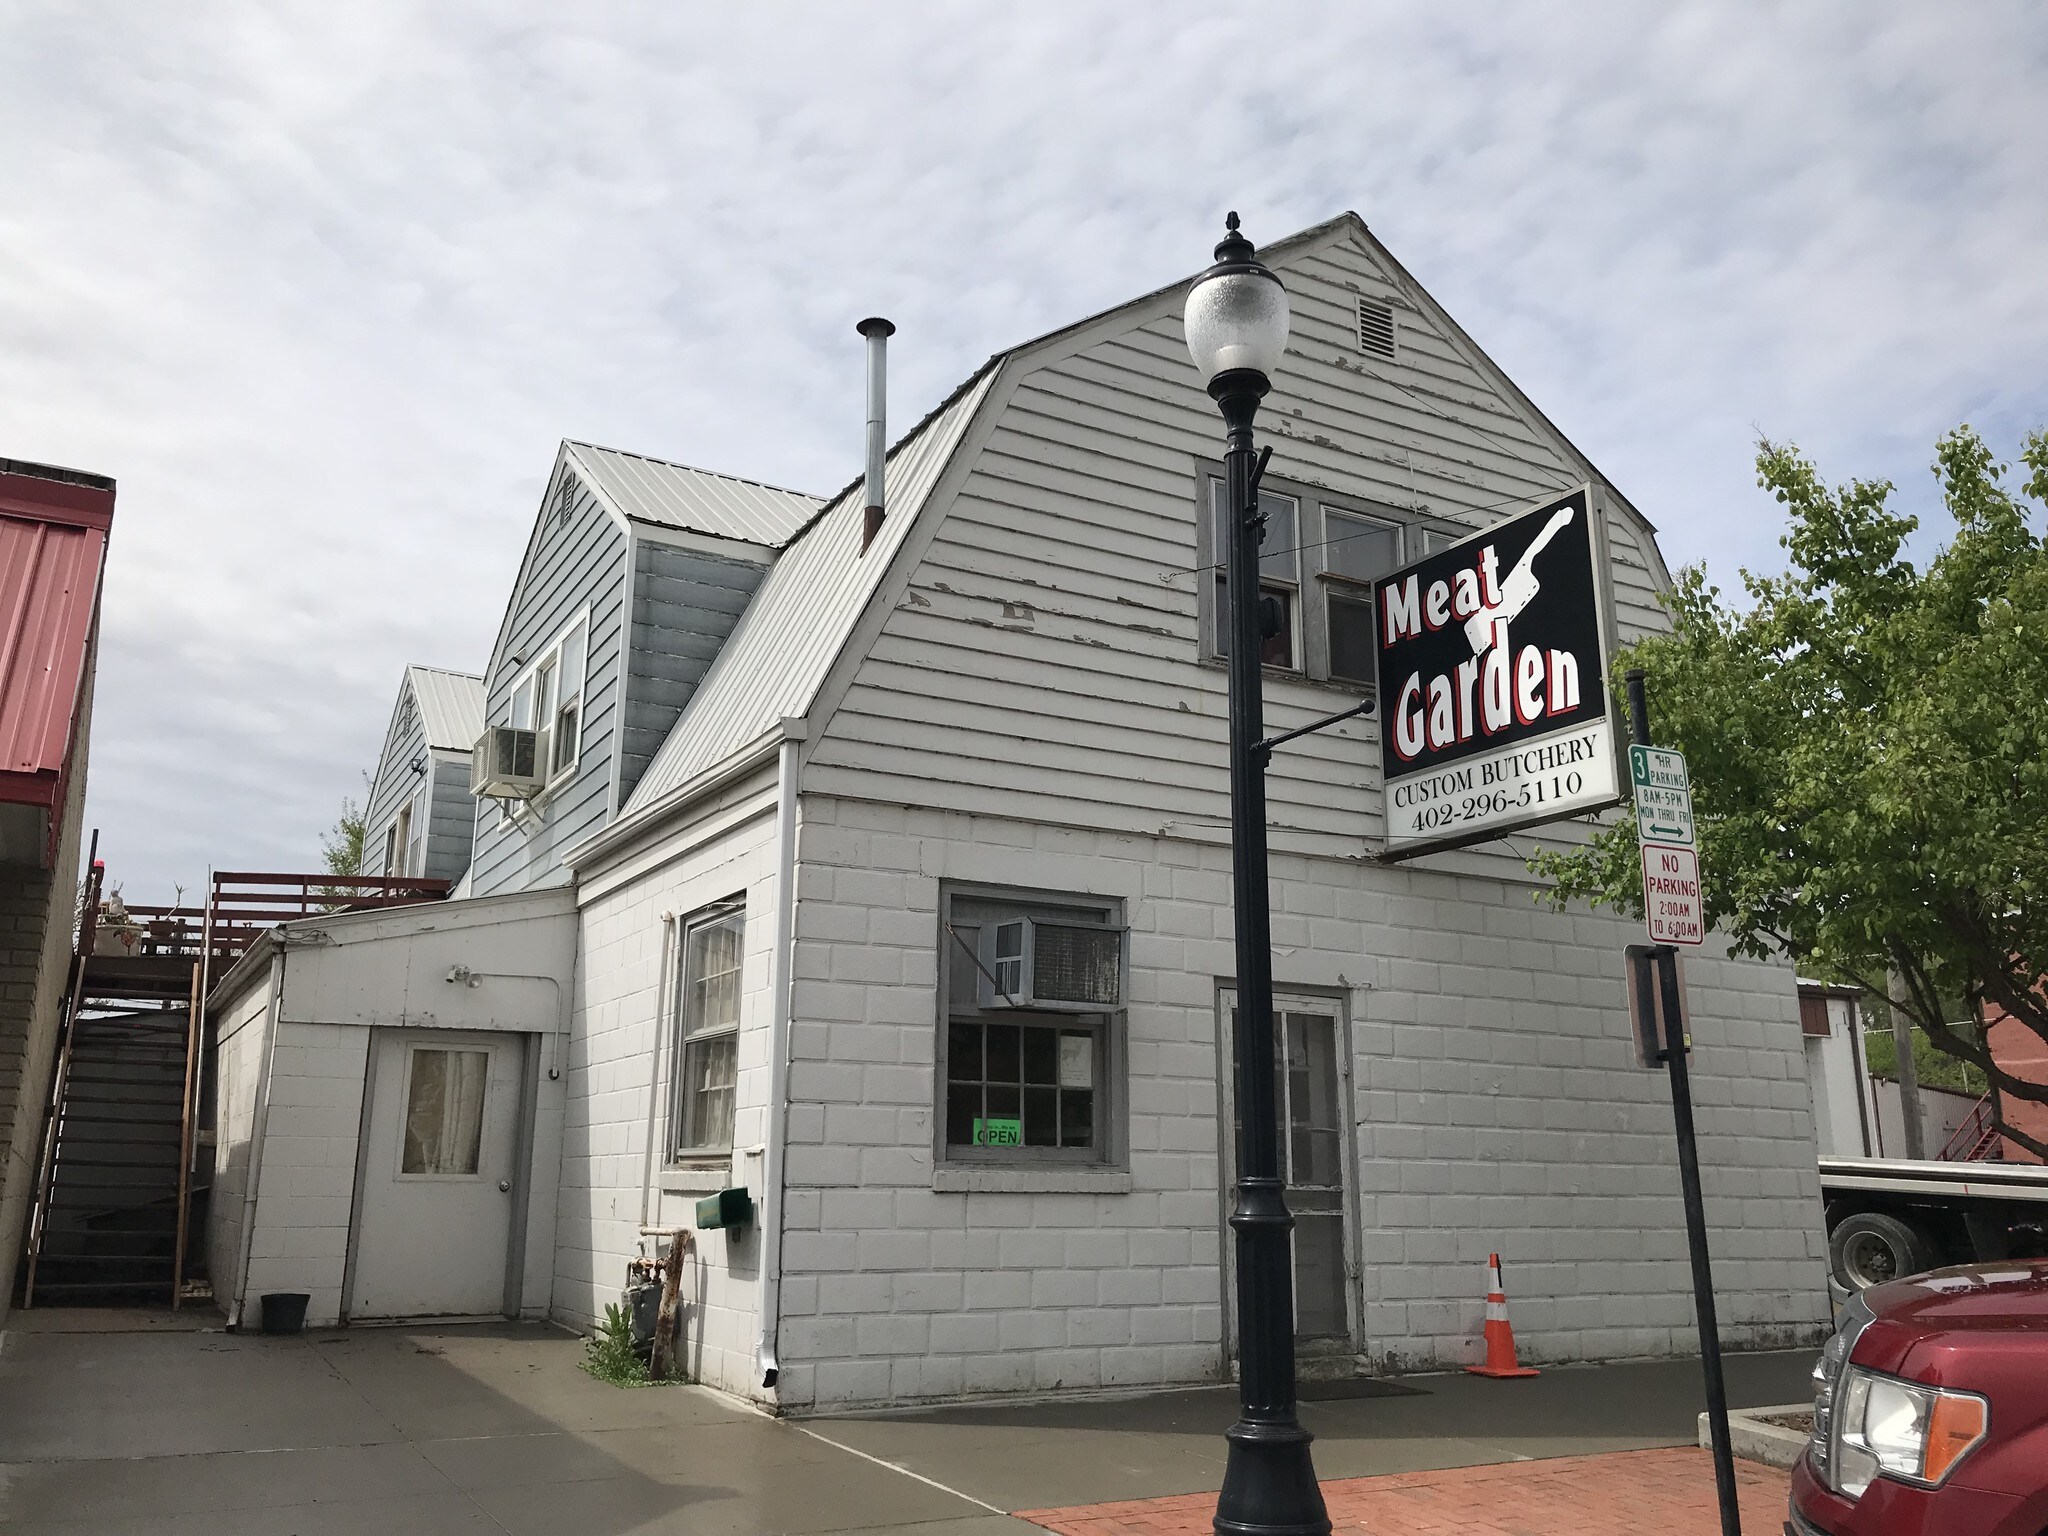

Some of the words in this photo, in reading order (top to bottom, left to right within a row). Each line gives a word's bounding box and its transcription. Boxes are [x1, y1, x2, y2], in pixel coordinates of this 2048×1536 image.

[1383, 544, 1504, 649] Meat
[1392, 616, 1581, 762] Garden
[1394, 767, 1474, 808] CUSTOM
[1480, 733, 1598, 786] BUTCHERY
[1633, 751, 1646, 780] 3
[1658, 755, 1672, 769] HR
[1650, 770, 1684, 787] PARKING
[1411, 771, 1583, 832] 402-296-5110
[1643, 788, 1683, 807] 8AM-5PM
[1639, 805, 1655, 819] MON
[1657, 808, 1675, 822] THRU
[1678, 811, 1690, 824] FRI
[1661, 854, 1679, 873] NO
[1648, 876, 1696, 897] PARKING
[1659, 900, 1690, 917] 2:00AM
[1653, 919, 1664, 934] TO
[1667, 921, 1698, 937] 6:00AM
[977, 1130, 1018, 1144] OPEN
